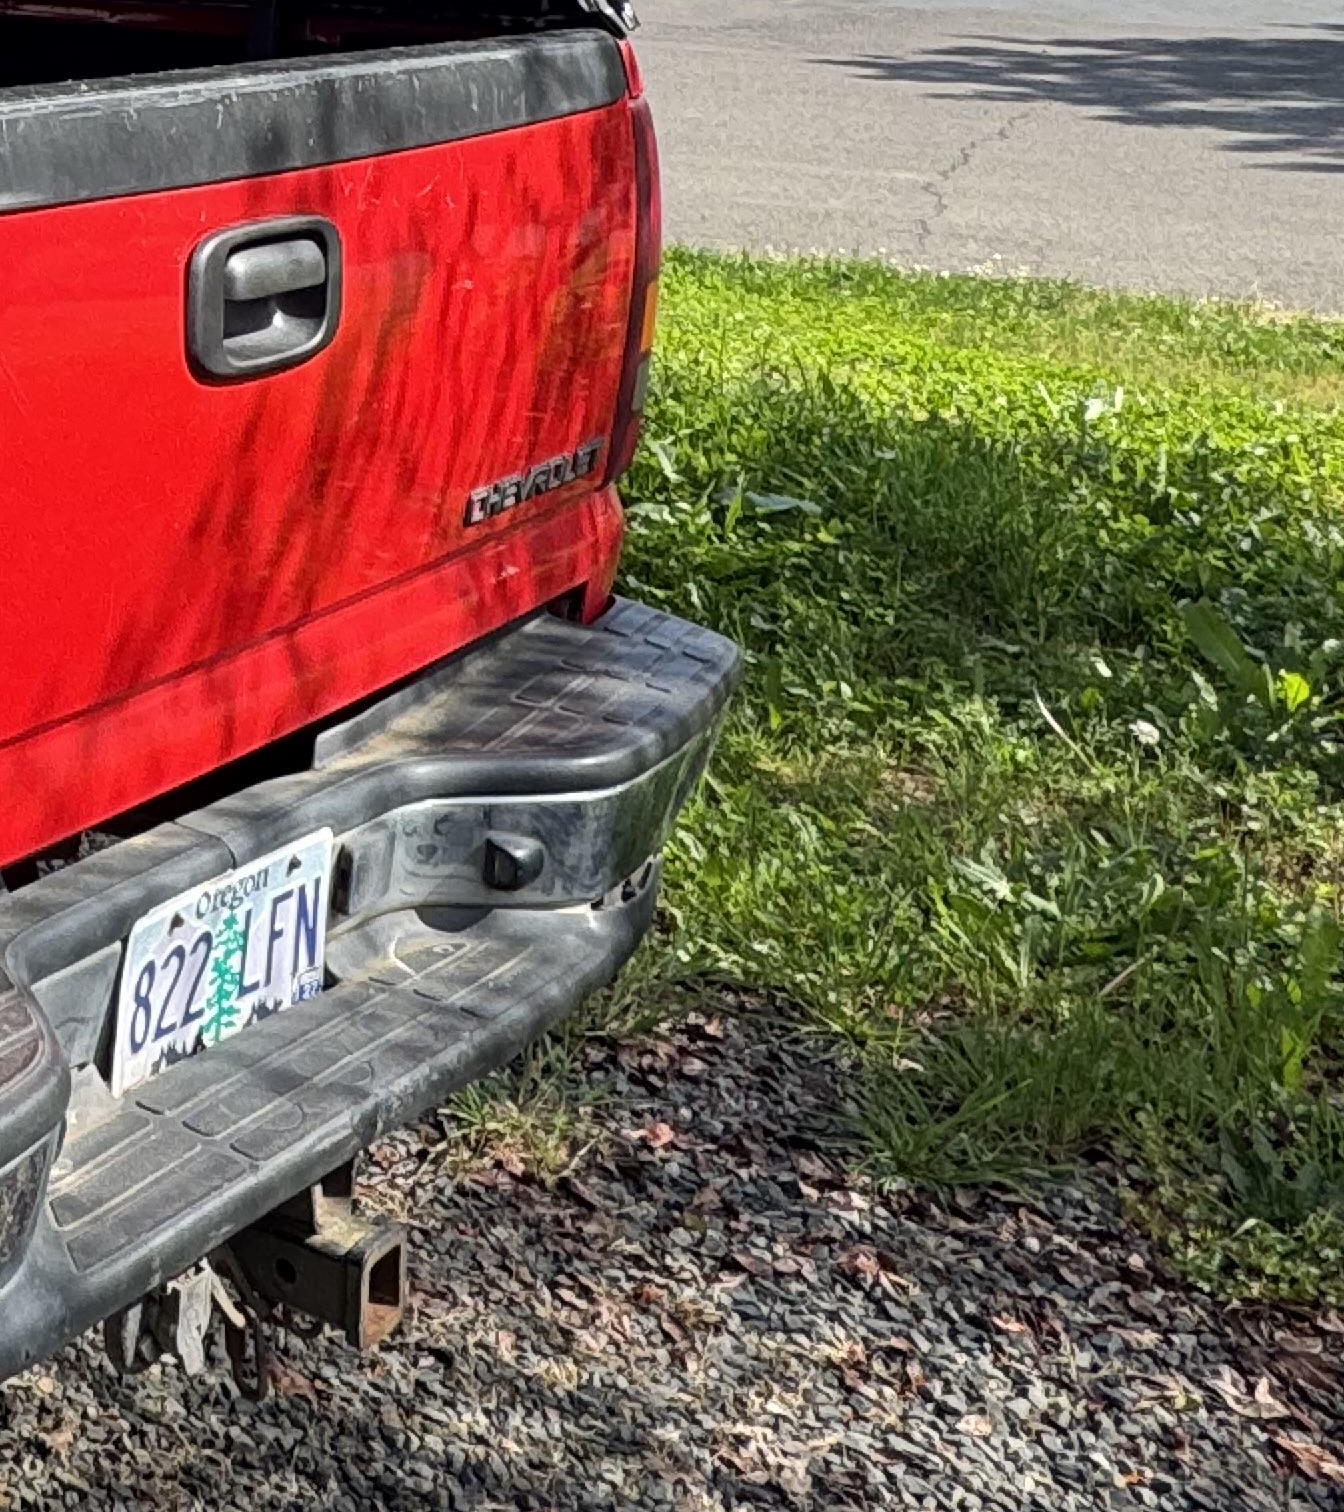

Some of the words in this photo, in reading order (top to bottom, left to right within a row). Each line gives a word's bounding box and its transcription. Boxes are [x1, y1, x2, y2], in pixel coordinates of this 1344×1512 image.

[465, 437, 605, 526] CHEVROLET
[195, 866, 271, 920] Oregon
[130, 930, 214, 1055] 822
[237, 875, 322, 1001] LFN
